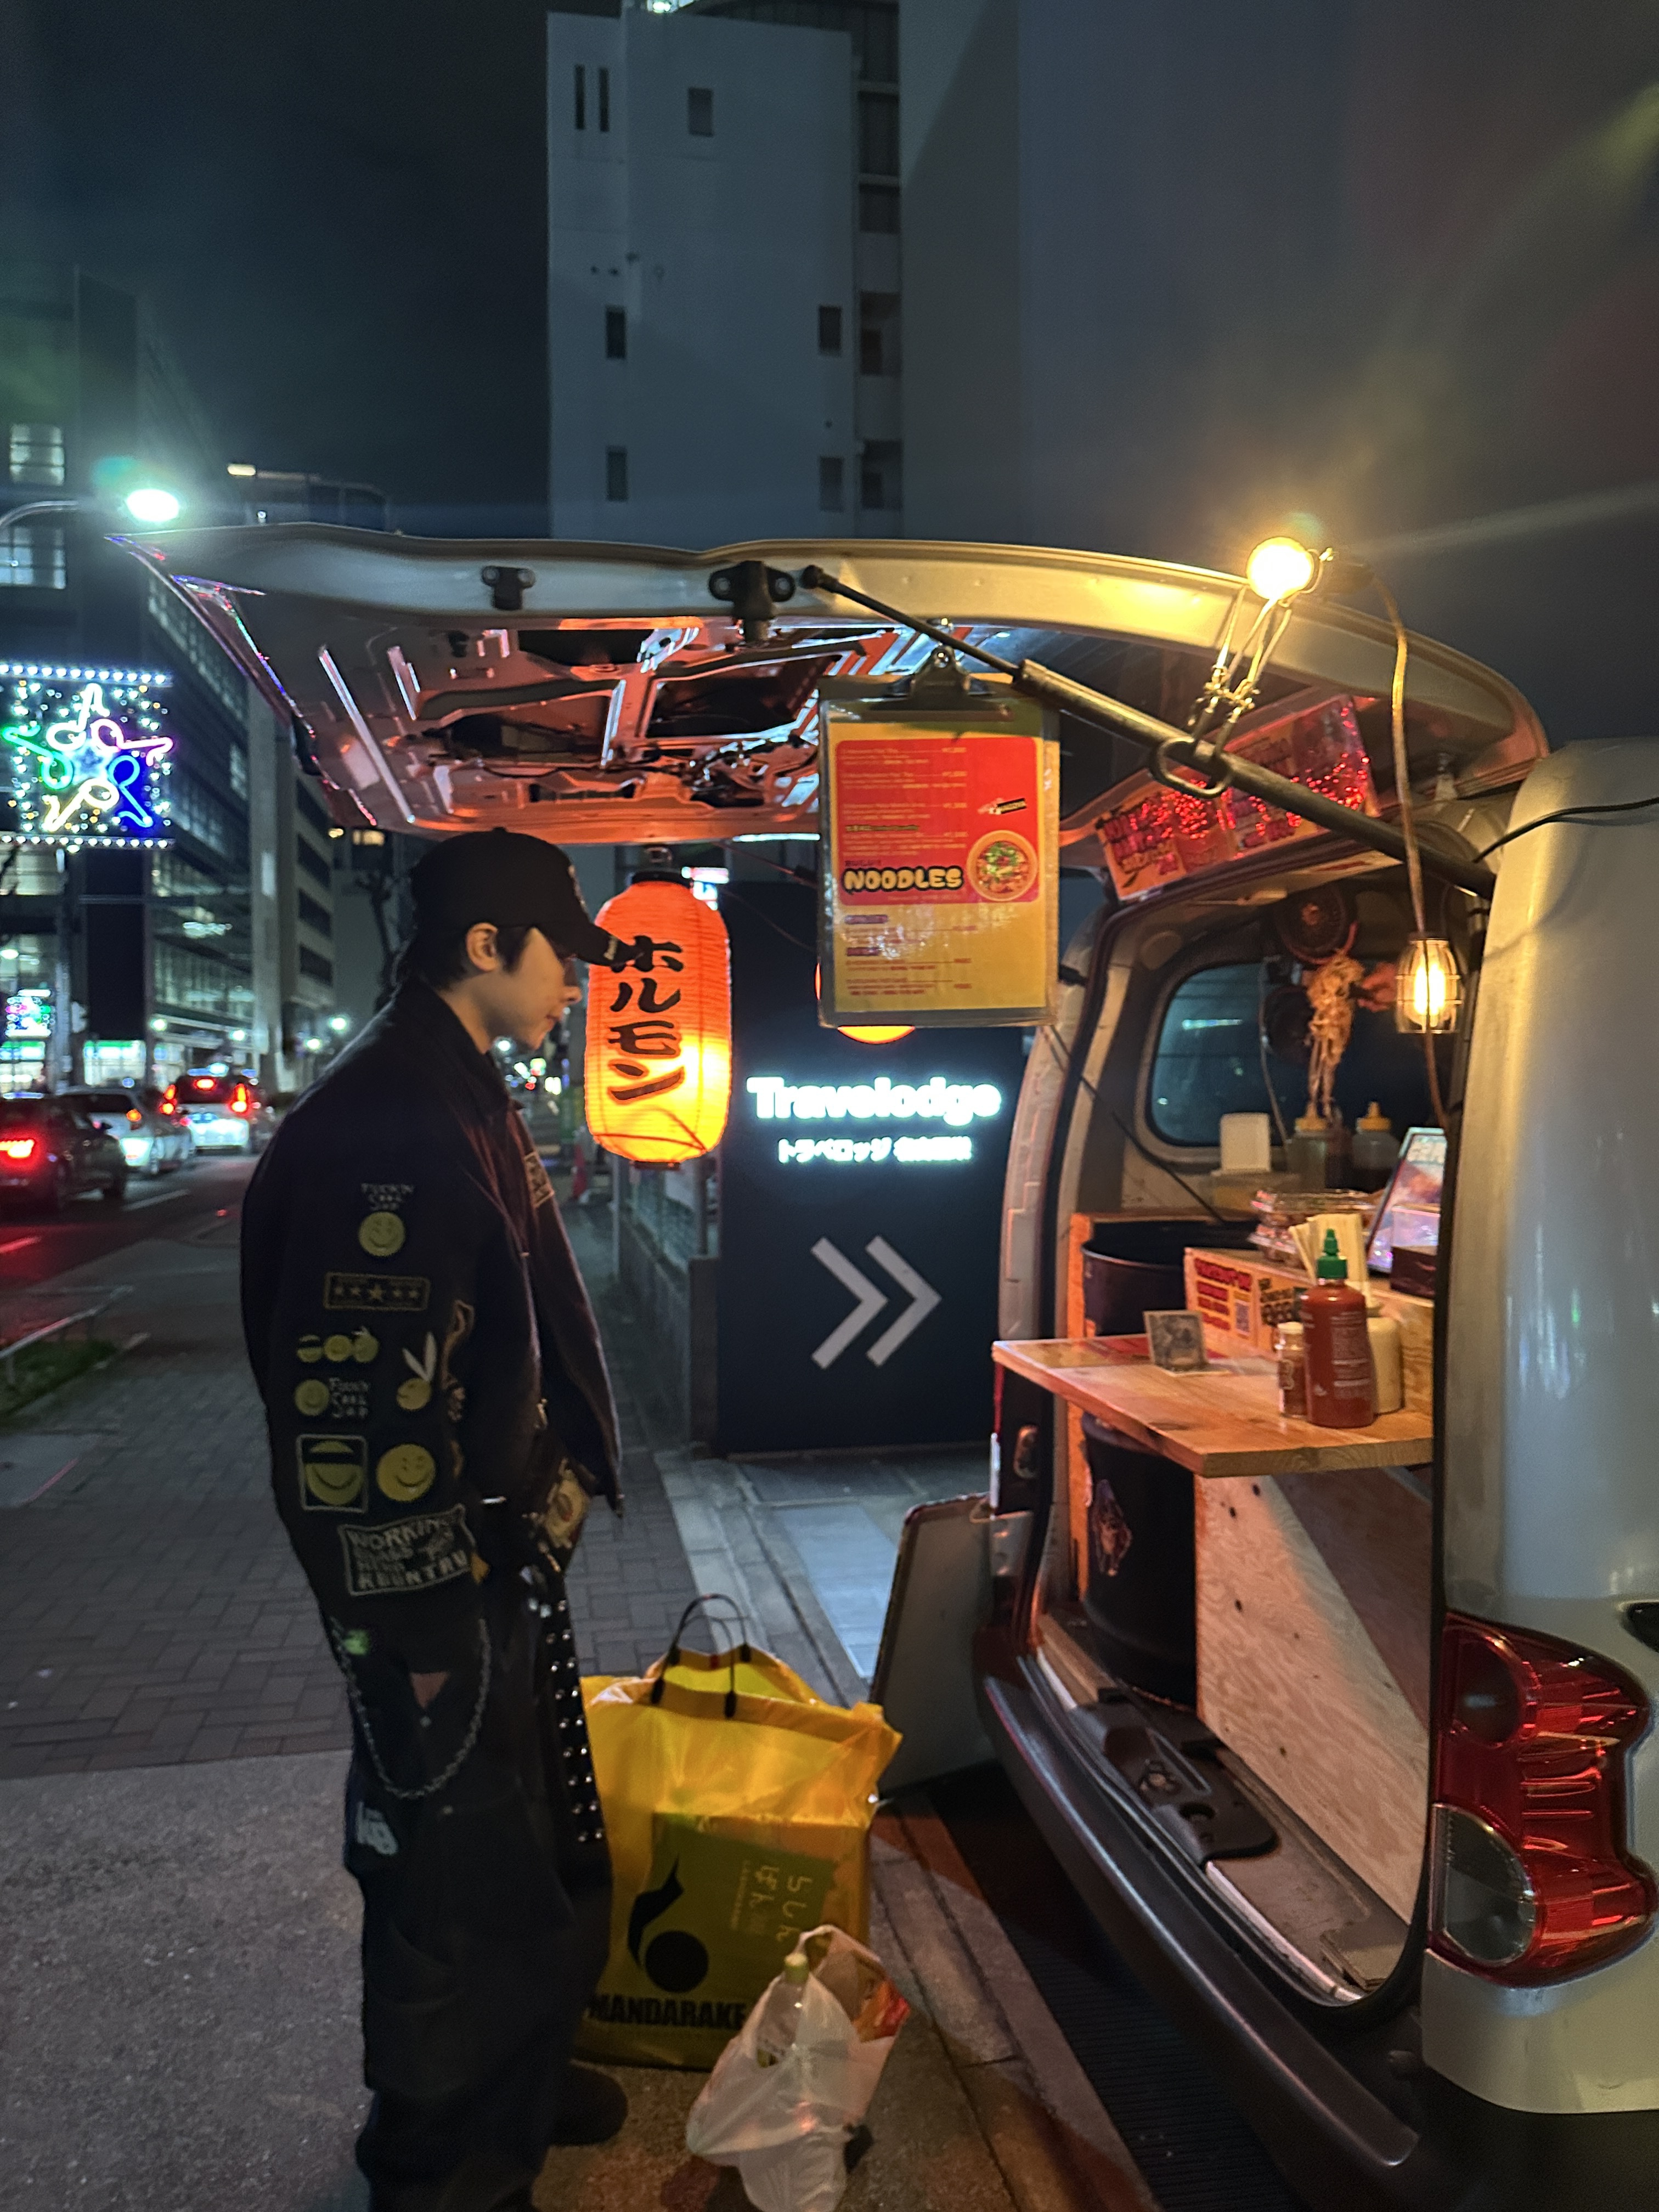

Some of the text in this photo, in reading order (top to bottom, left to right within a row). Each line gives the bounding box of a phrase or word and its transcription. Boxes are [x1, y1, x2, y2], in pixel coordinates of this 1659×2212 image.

[843, 866, 963, 891] NOODLES
[608, 935, 685, 1102] ホルモン
[746, 1076, 1001, 1126] Travelodge
